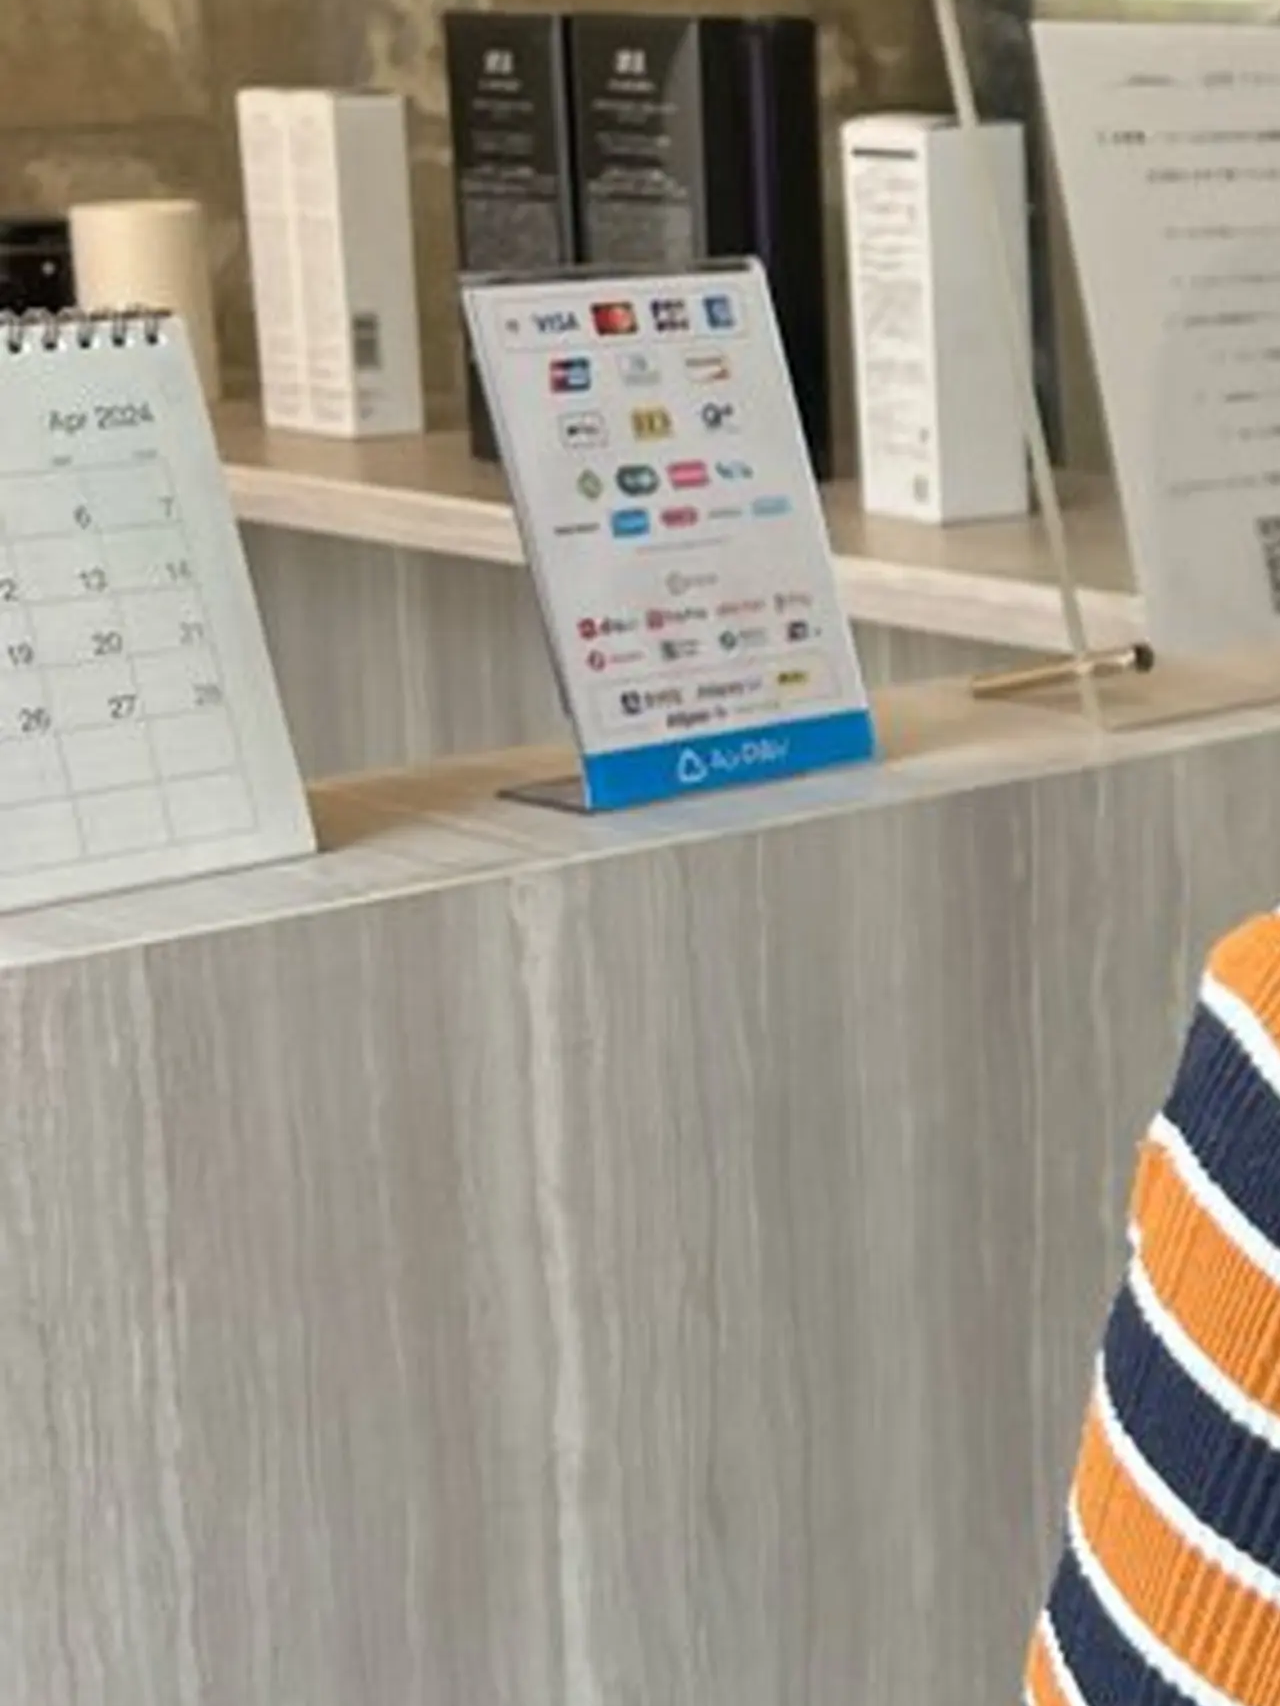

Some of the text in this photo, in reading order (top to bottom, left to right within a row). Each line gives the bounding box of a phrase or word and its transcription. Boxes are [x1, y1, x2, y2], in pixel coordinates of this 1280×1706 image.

[534, 311, 580, 334] VISA
[49, 400, 155, 435] Apr 2024
[73, 504, 92, 530] 6
[91, 630, 123, 656] 20
[107, 693, 137, 720] 27
